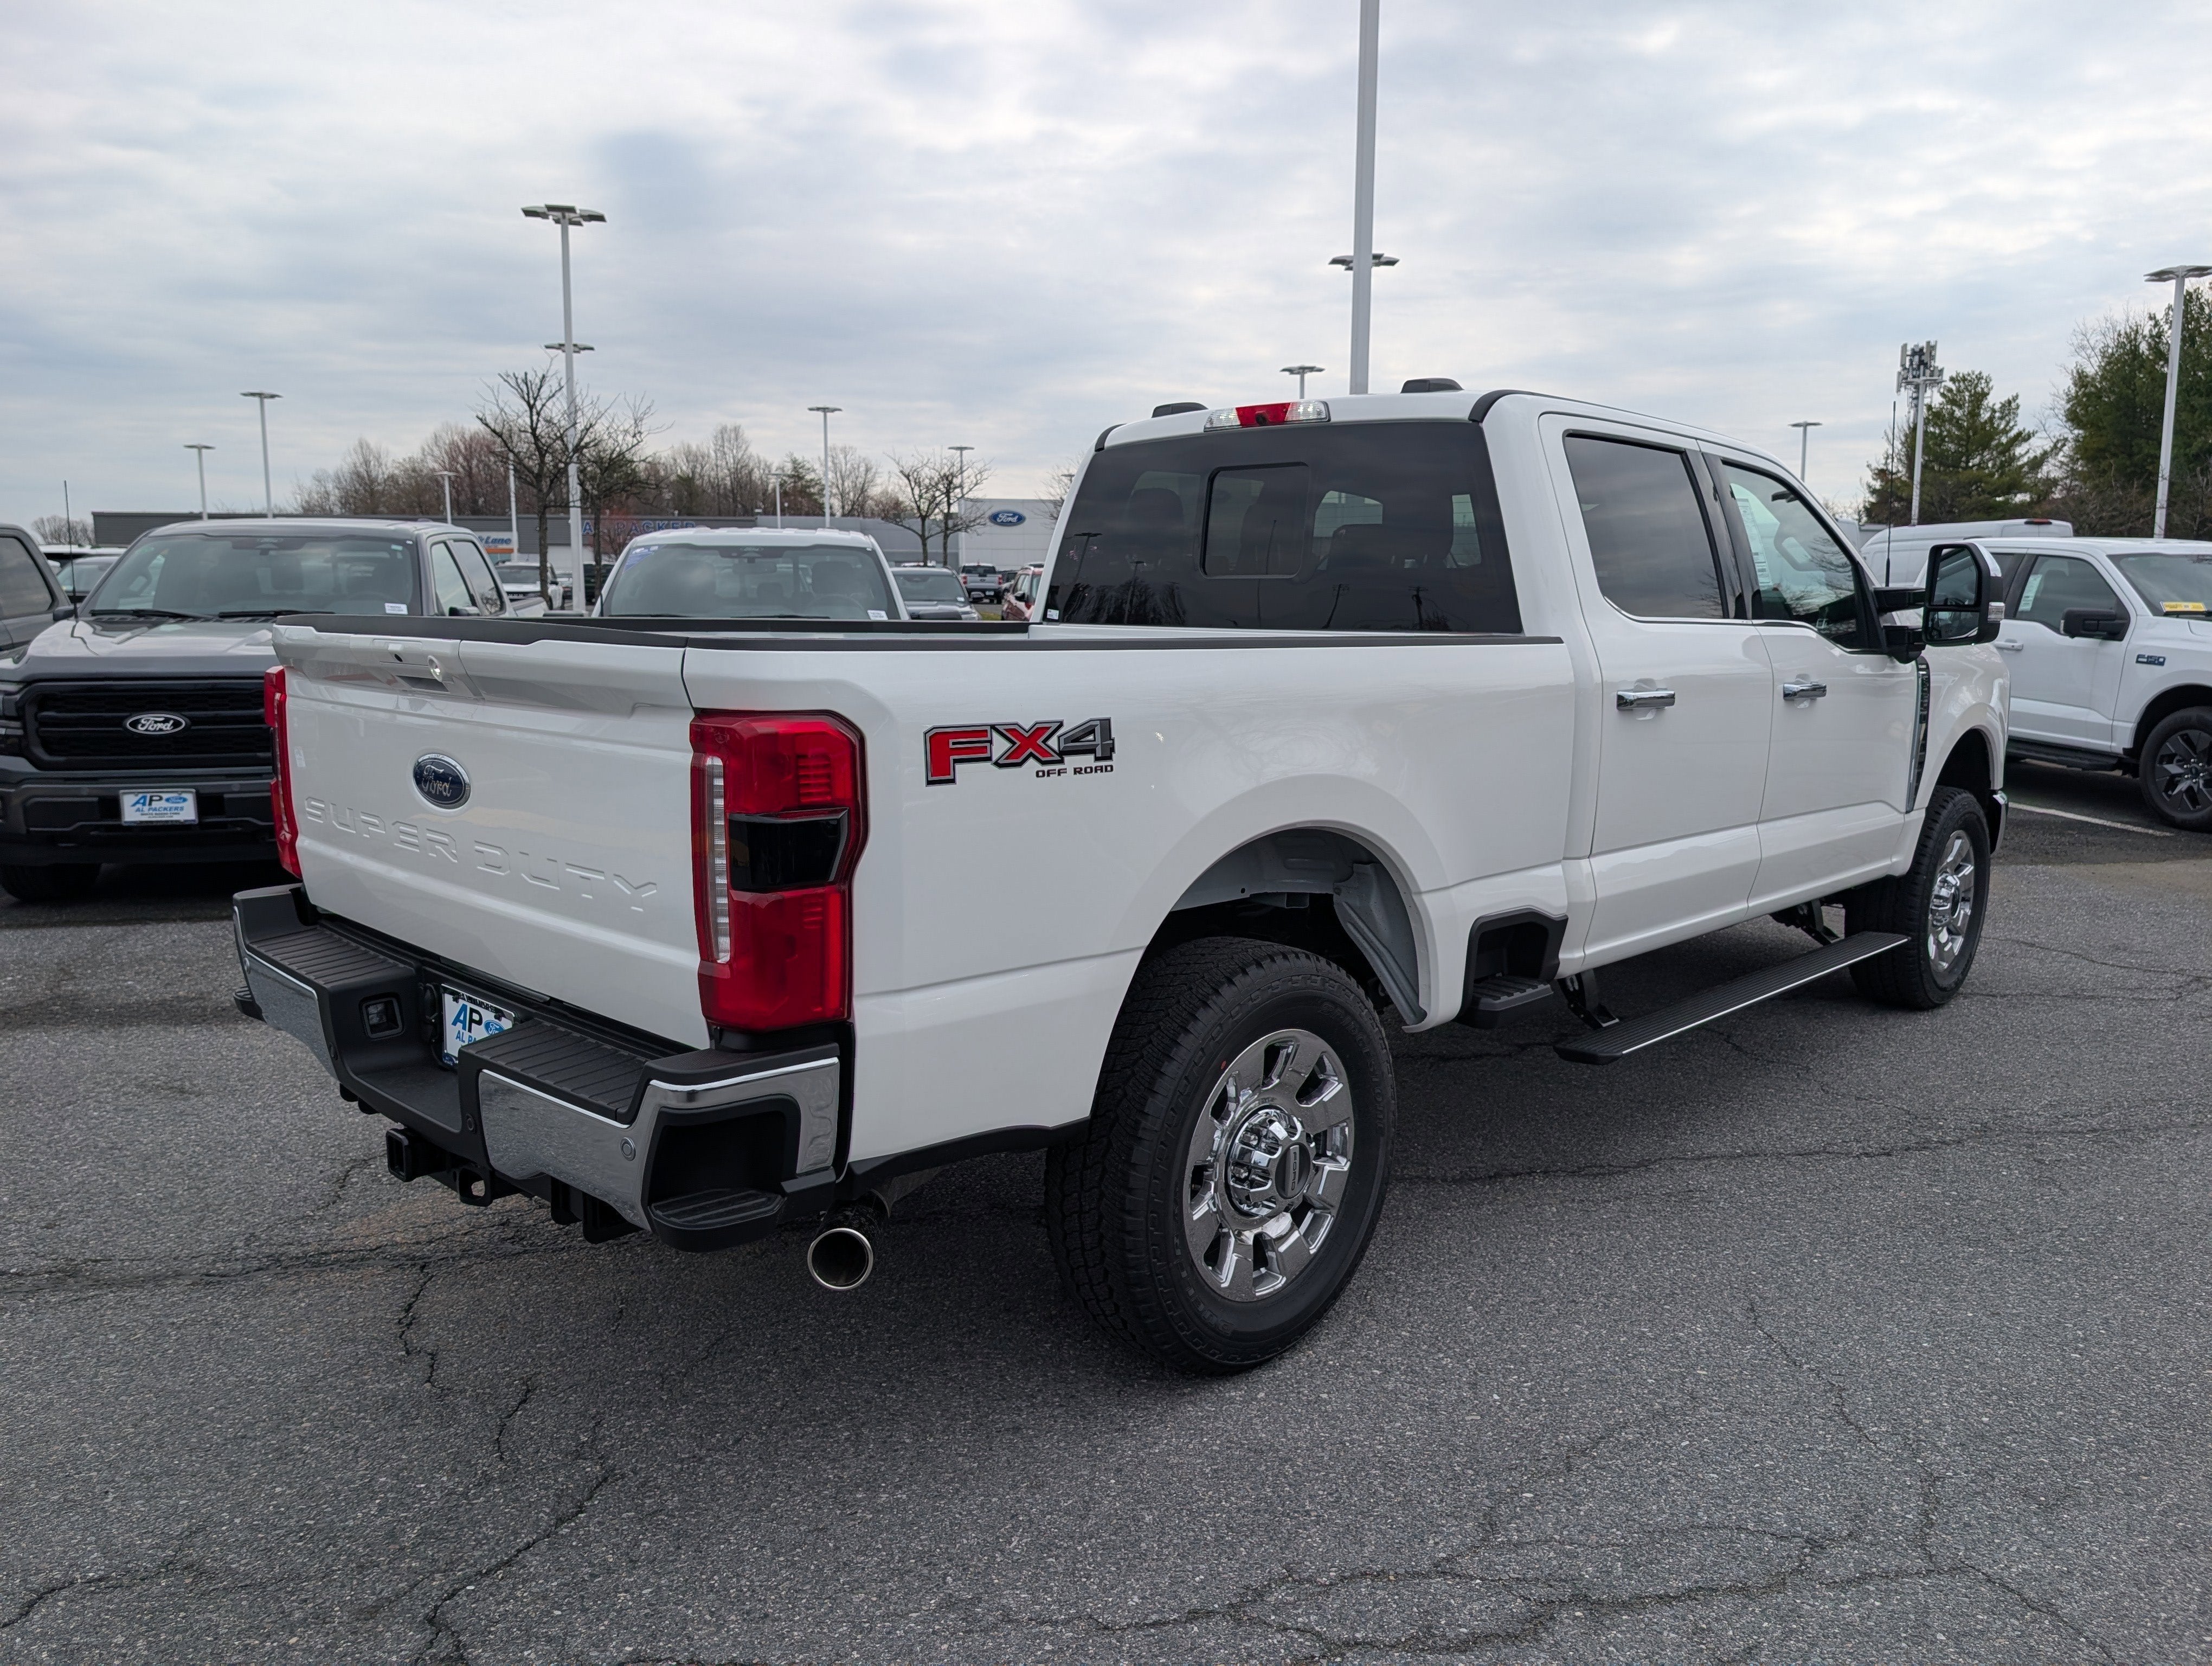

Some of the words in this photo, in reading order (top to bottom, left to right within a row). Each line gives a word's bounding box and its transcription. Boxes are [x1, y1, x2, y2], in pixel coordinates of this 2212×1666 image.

[996, 513, 1019, 522] Ford
[484, 536, 512, 544] Lane
[138, 716, 174, 731] Ford
[924, 717, 1116, 787] FX4
[1036, 767, 1068, 778] OFF
[1073, 764, 1114, 776] ROAD
[421, 764, 452, 797] Ford
[131, 795, 163, 806] AP
[305, 797, 458, 862] SUPER
[474, 840, 658, 912] DUTY
[451, 1003, 483, 1034] AP
[455, 1030, 465, 1043] AL
